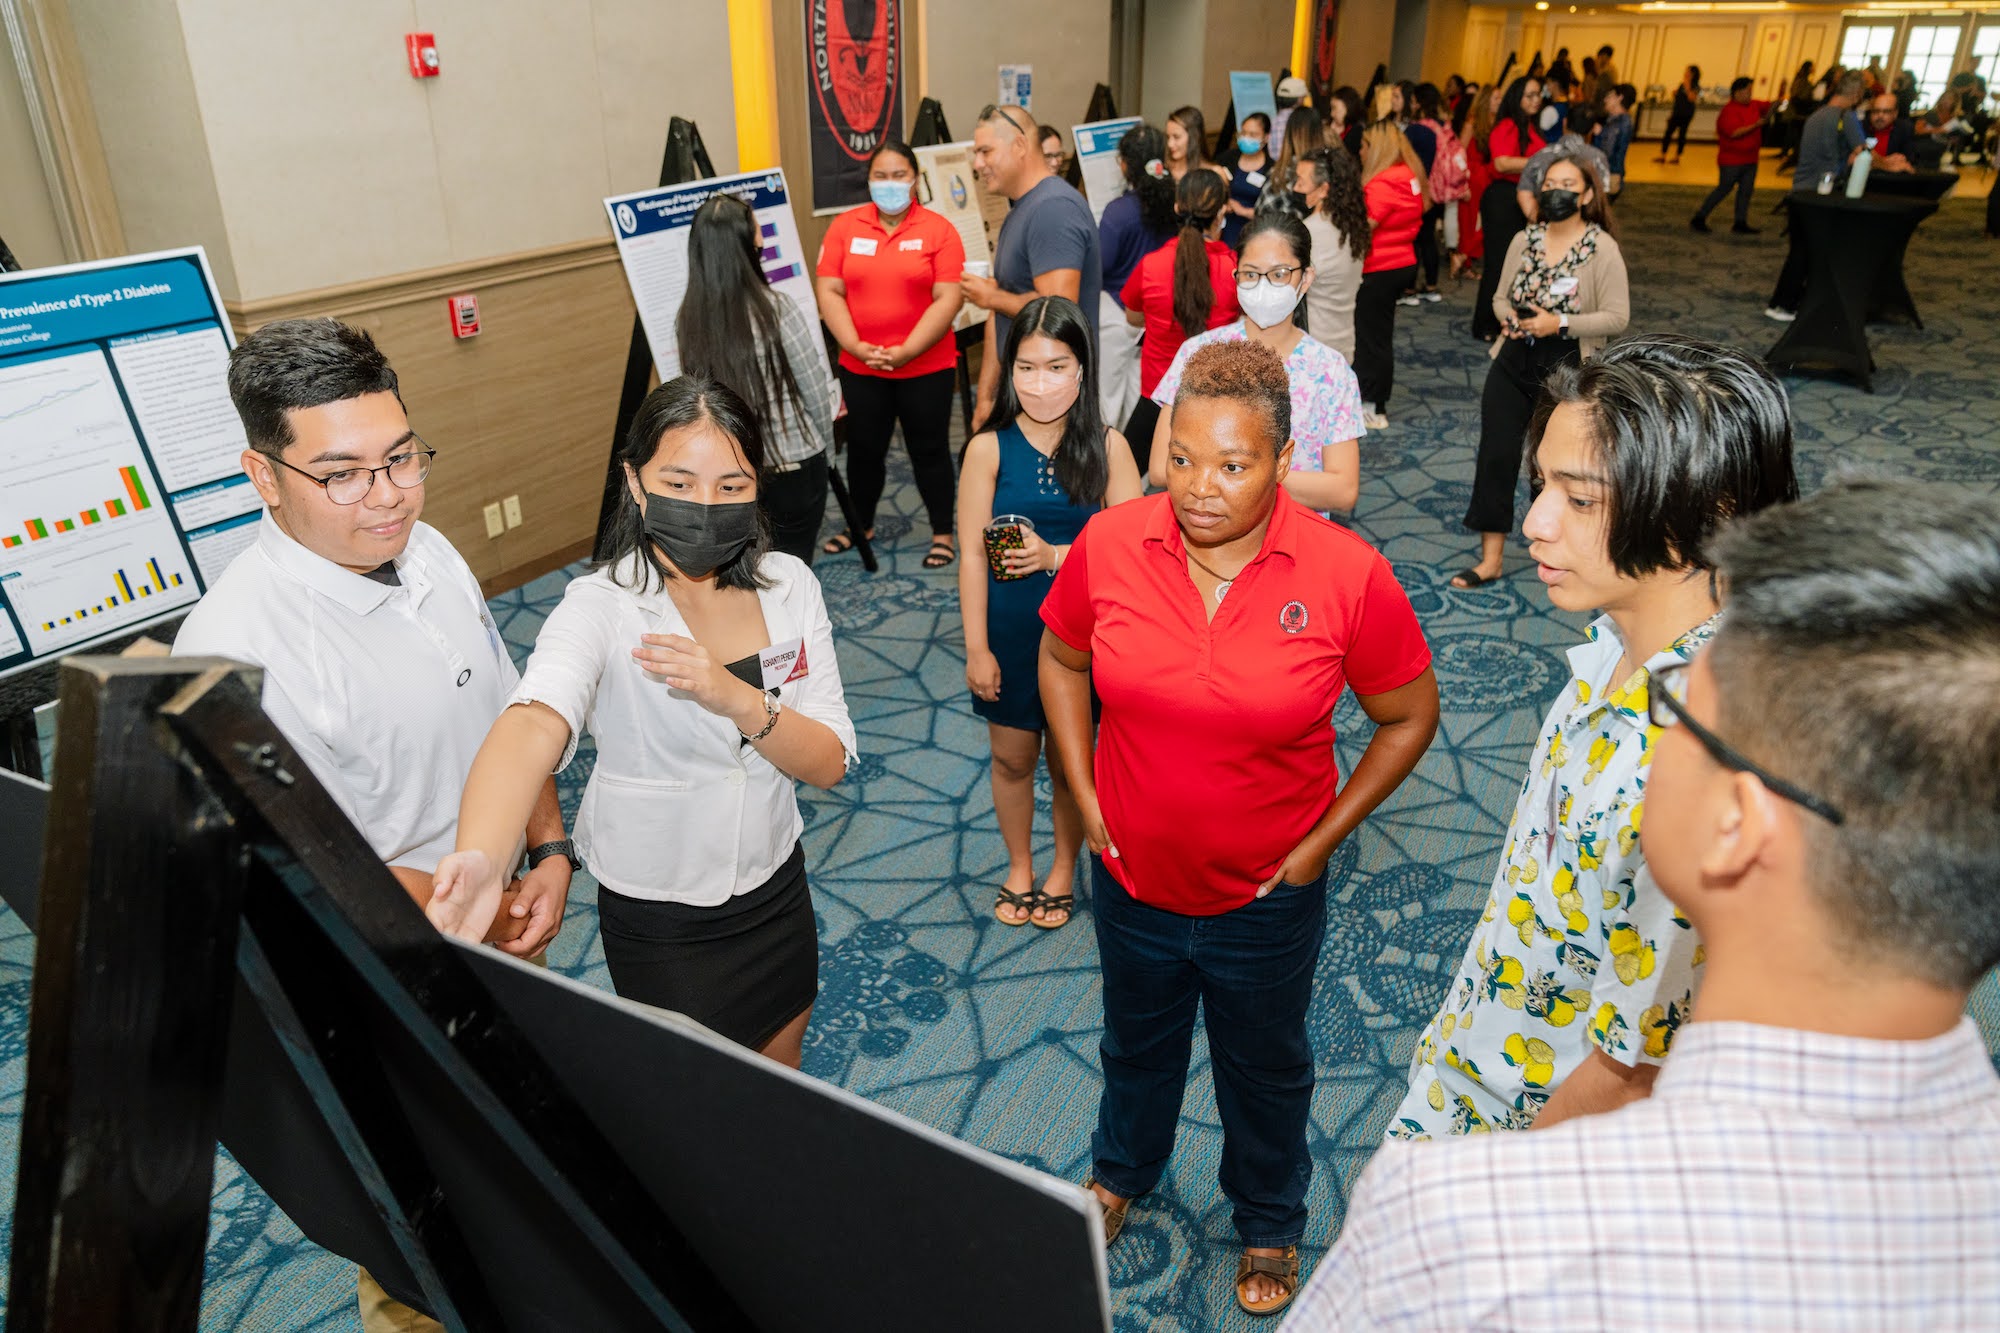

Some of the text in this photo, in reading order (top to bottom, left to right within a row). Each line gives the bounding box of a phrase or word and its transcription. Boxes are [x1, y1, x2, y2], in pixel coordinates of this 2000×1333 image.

[0, 283, 171, 319] Prevalence of Type 2 Diabetes
